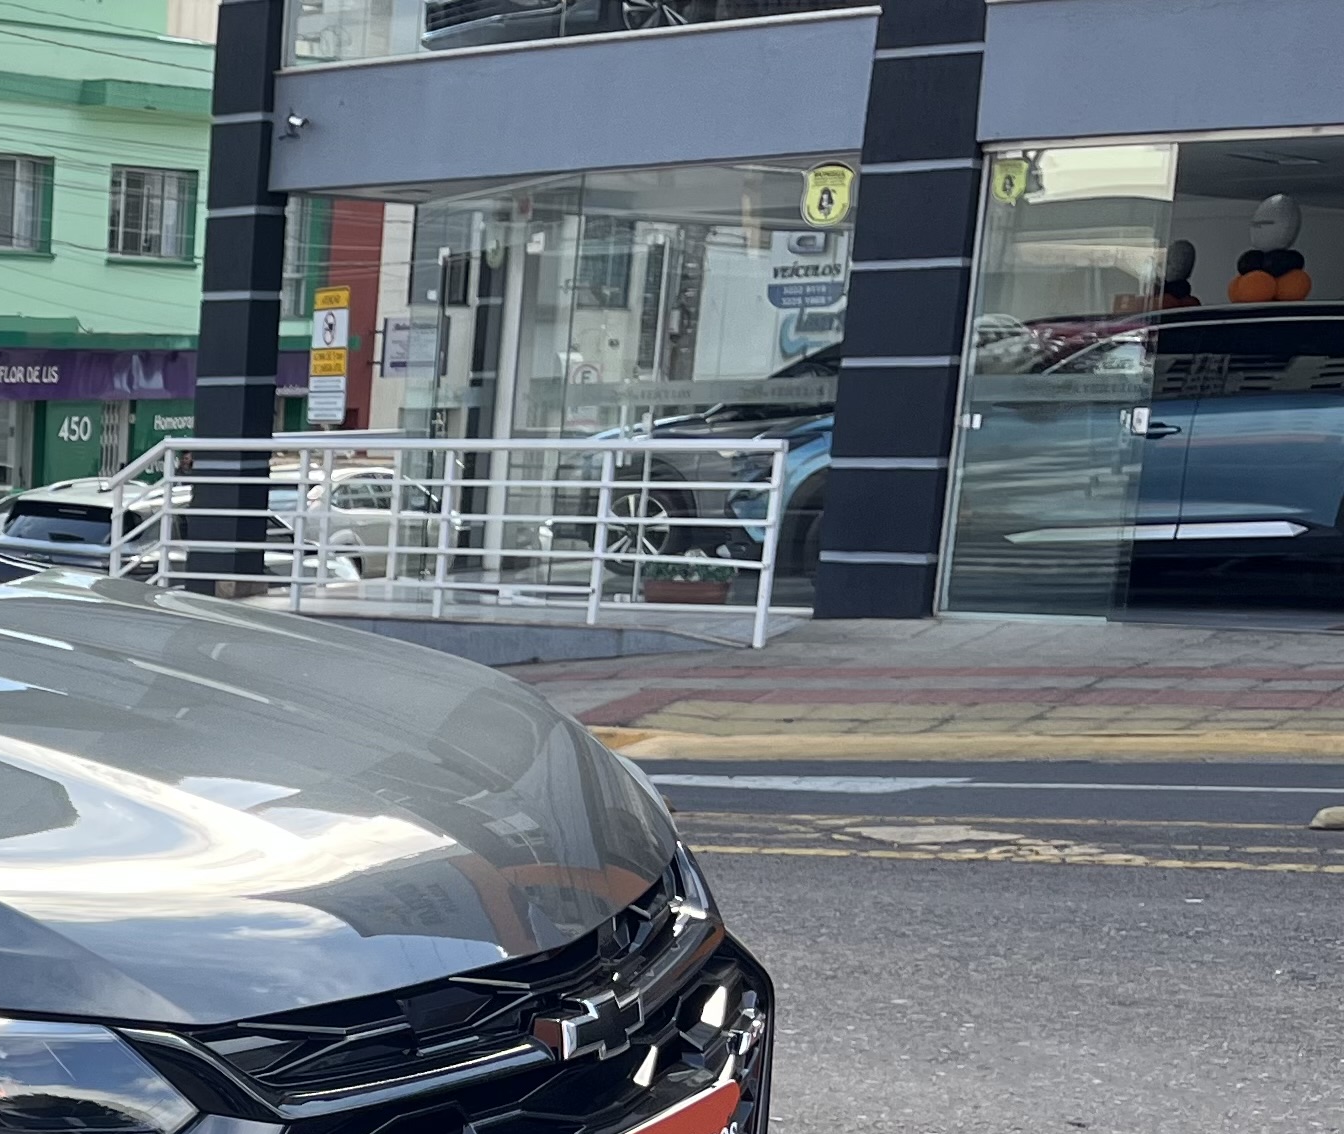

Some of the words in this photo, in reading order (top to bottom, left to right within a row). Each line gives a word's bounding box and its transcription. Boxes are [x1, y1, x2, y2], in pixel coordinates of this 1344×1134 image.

[26, 366, 41, 384] DE
[42, 366, 59, 384] LIS
[58, 416, 92, 442] 450
